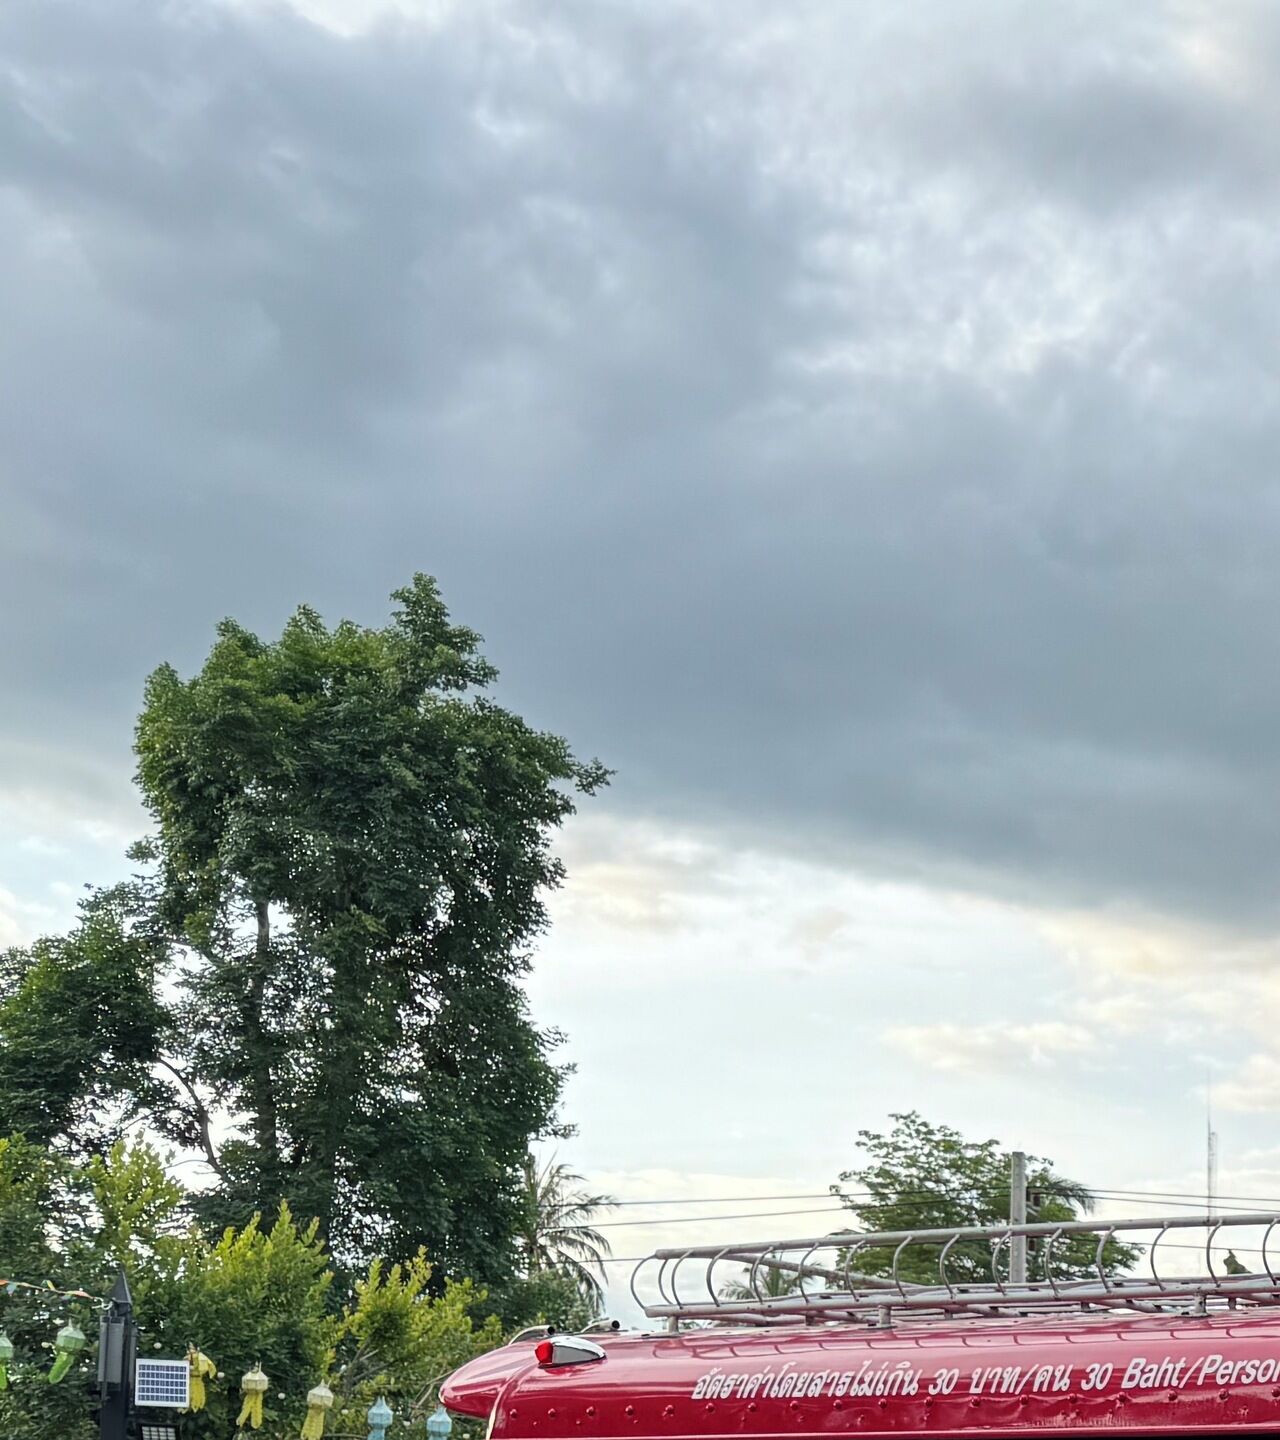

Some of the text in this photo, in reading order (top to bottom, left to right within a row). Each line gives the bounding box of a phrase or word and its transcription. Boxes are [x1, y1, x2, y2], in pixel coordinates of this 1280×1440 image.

[691, 1359, 922, 1399] อัตราค่าโดยสารไม่เกิน
[928, 1368, 960, 1395] 30
[970, 1362, 1073, 1395] บาท/คน
[1081, 1363, 1113, 1390] 30
